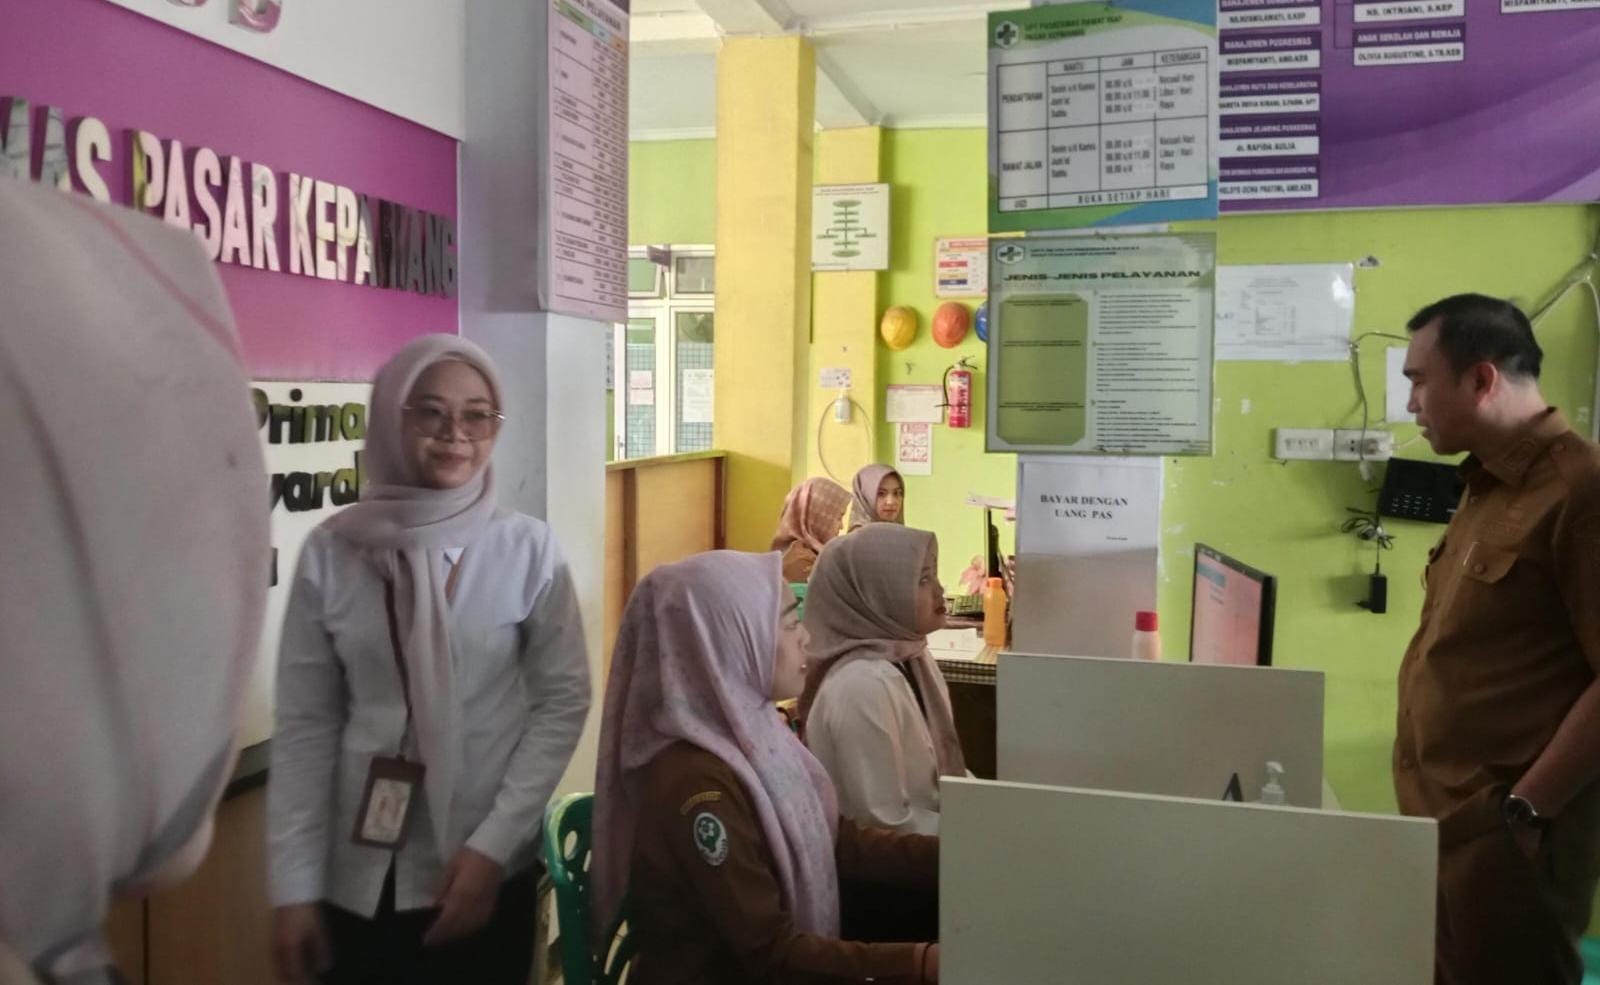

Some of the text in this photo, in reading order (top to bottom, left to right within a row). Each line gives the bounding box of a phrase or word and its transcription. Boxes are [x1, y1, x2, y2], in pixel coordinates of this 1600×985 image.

[130, 129, 281, 272] PASAR
[1078, 194, 1102, 204] BUKA
[1108, 191, 1141, 201] SETIAP
[1146, 189, 1170, 199] HARI
[1101, 270, 1201, 279] PELAYANAN
[1040, 494, 1128, 506] BAYAR DENGAN
[1055, 509, 1113, 519] UANG PAS
